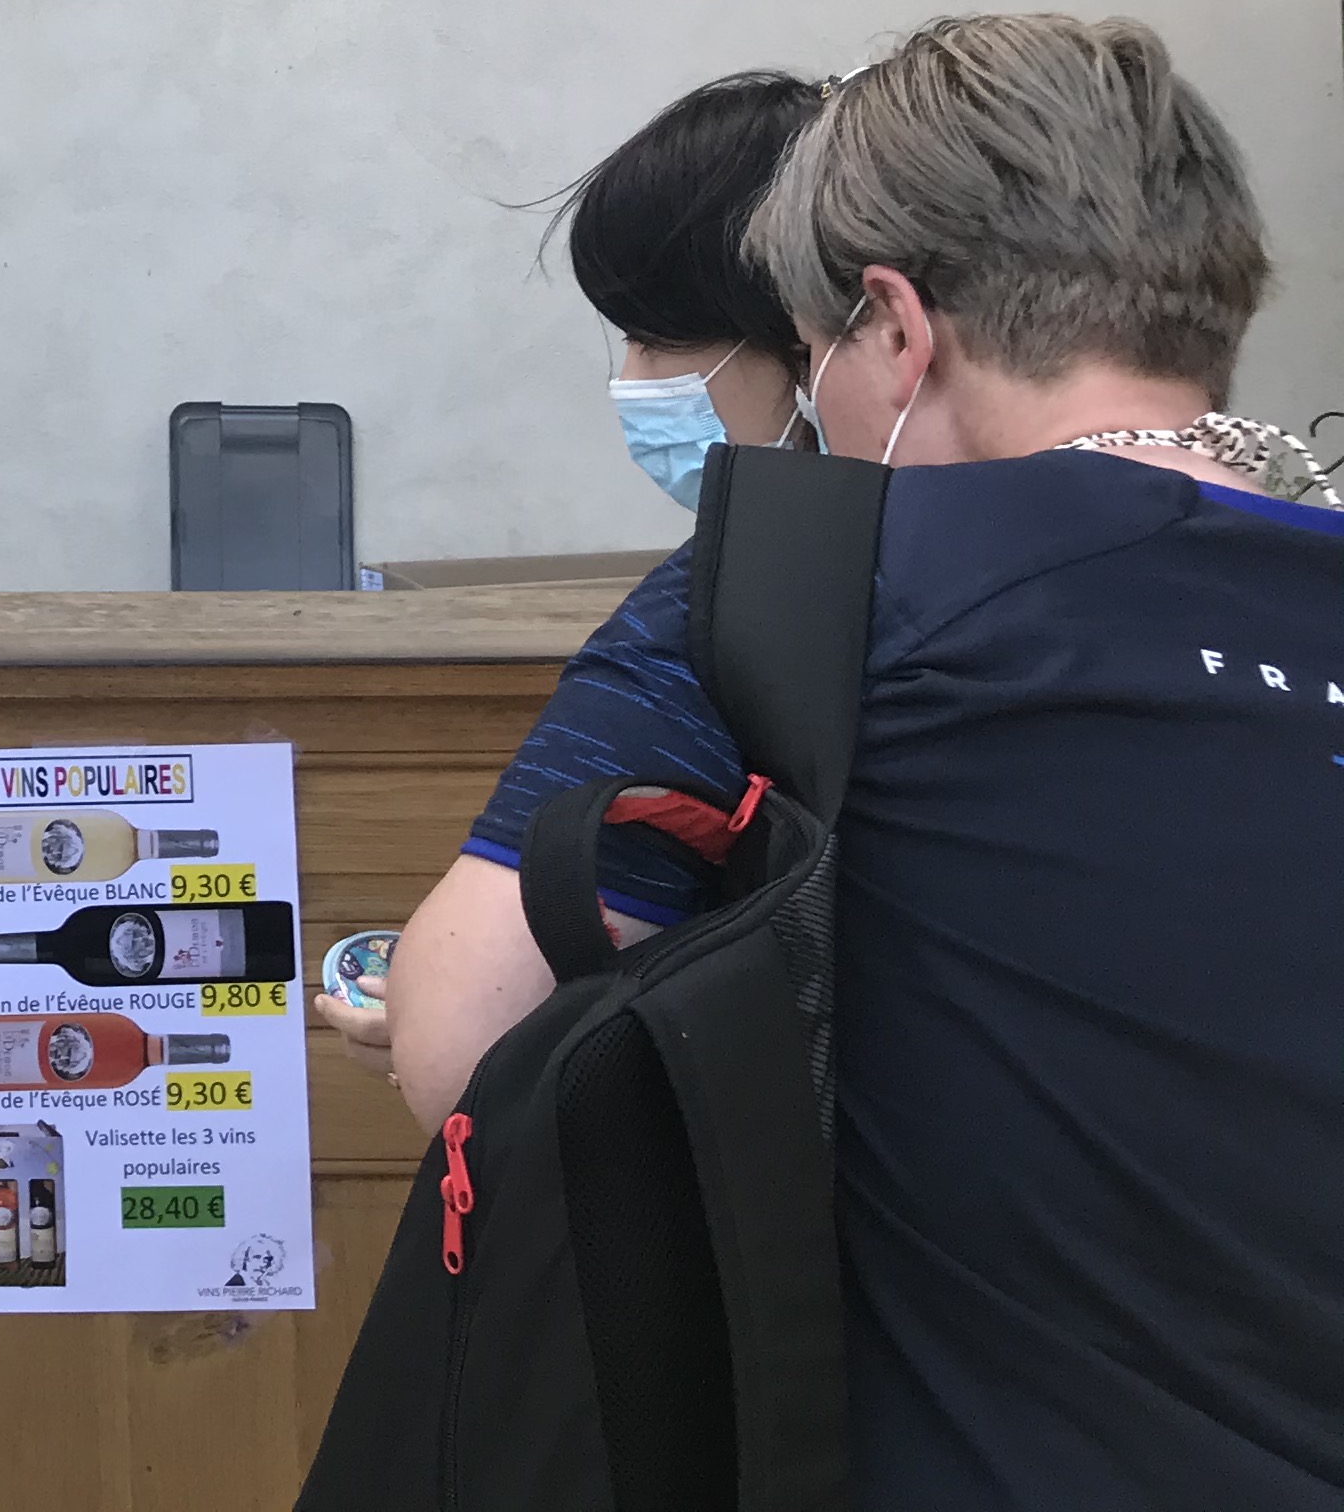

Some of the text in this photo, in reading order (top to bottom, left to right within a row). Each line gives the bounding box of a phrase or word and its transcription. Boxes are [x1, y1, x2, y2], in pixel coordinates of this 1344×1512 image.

[0, 764, 186, 798] VINS POPULAIRES
[106, 882, 166, 900] BLANC
[171, 874, 230, 902] 9,30
[240, 874, 256, 897] €
[18, 996, 40, 1013] de
[129, 992, 195, 1009] ROUGE
[201, 984, 261, 1011] 9,80
[269, 984, 286, 1007] €
[1, 1092, 23, 1109] de
[113, 1085, 161, 1106] ROSÉ
[167, 1082, 227, 1110] 9,30
[235, 1082, 252, 1104] €
[85, 1128, 256, 1147] Valisette les 3 vins
[123, 1159, 221, 1179] populaires
[123, 1195, 225, 1223] 28,40 €
[197, 1288, 220, 1297] VINS
[258, 1286, 303, 1296] RICHARD
